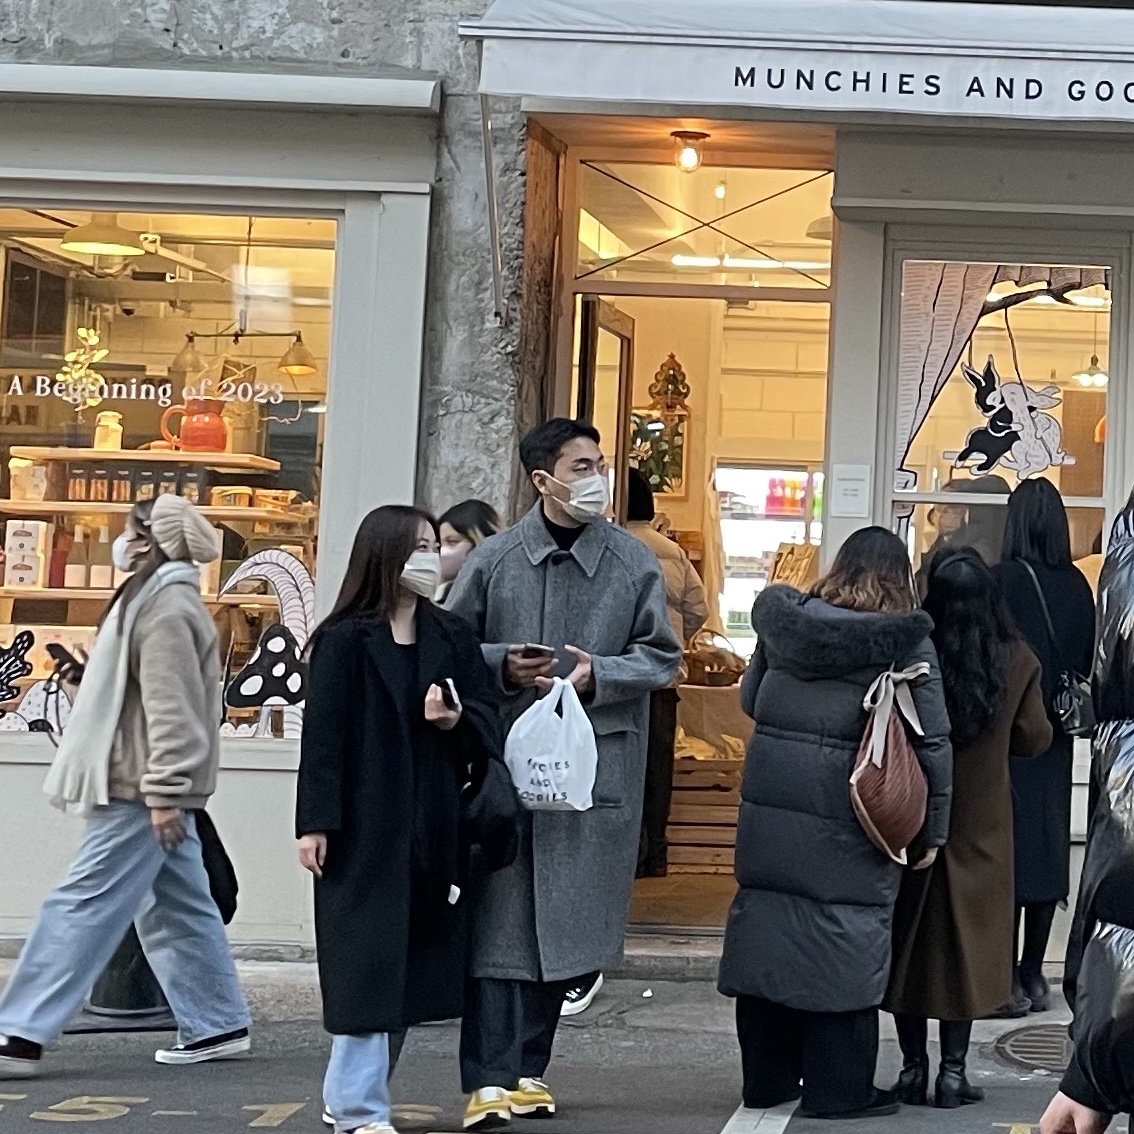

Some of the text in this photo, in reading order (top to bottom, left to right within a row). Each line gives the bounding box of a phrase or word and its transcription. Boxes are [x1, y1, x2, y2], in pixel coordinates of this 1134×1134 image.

[734, 66, 942, 97] MUNCHIES
[965, 76, 1043, 101] AND
[7, 374, 24, 397] A
[181, 378, 213, 401] of
[220, 379, 284, 405] 2023
